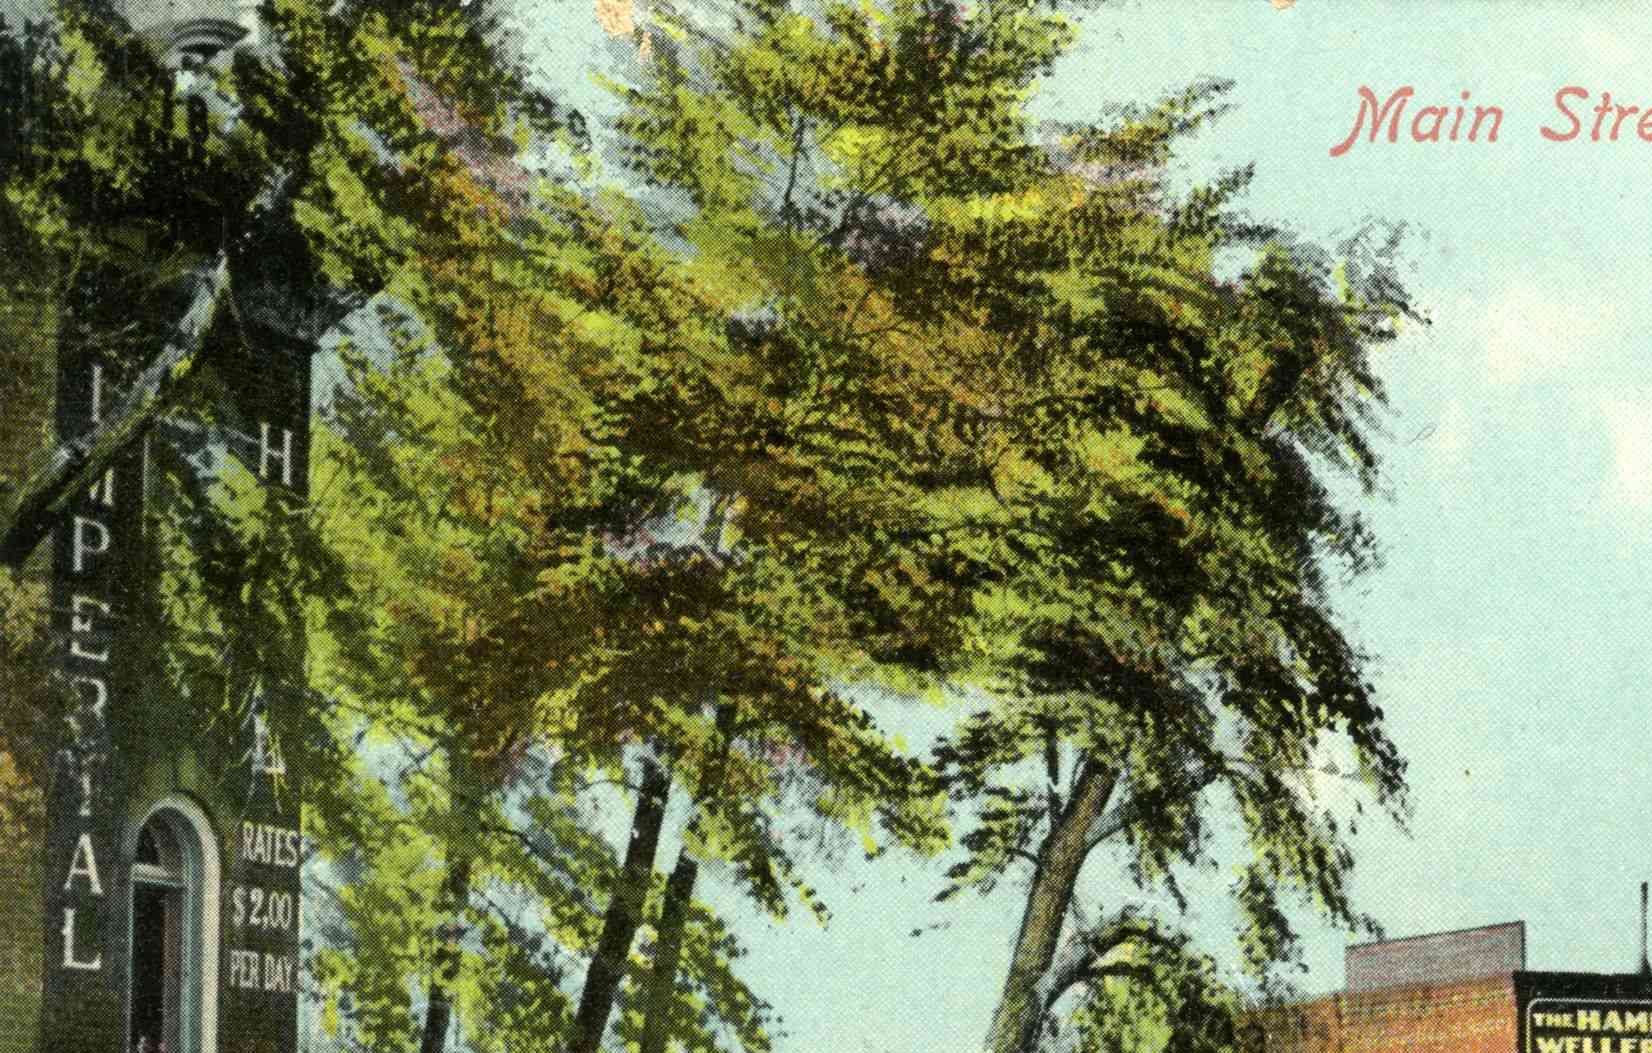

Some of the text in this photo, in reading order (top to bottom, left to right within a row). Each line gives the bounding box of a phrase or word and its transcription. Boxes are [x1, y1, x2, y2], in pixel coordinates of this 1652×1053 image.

[242, 820, 298, 868] RATES
[231, 950, 292, 991] PER DAY
[1533, 1012, 1574, 1028] THE
